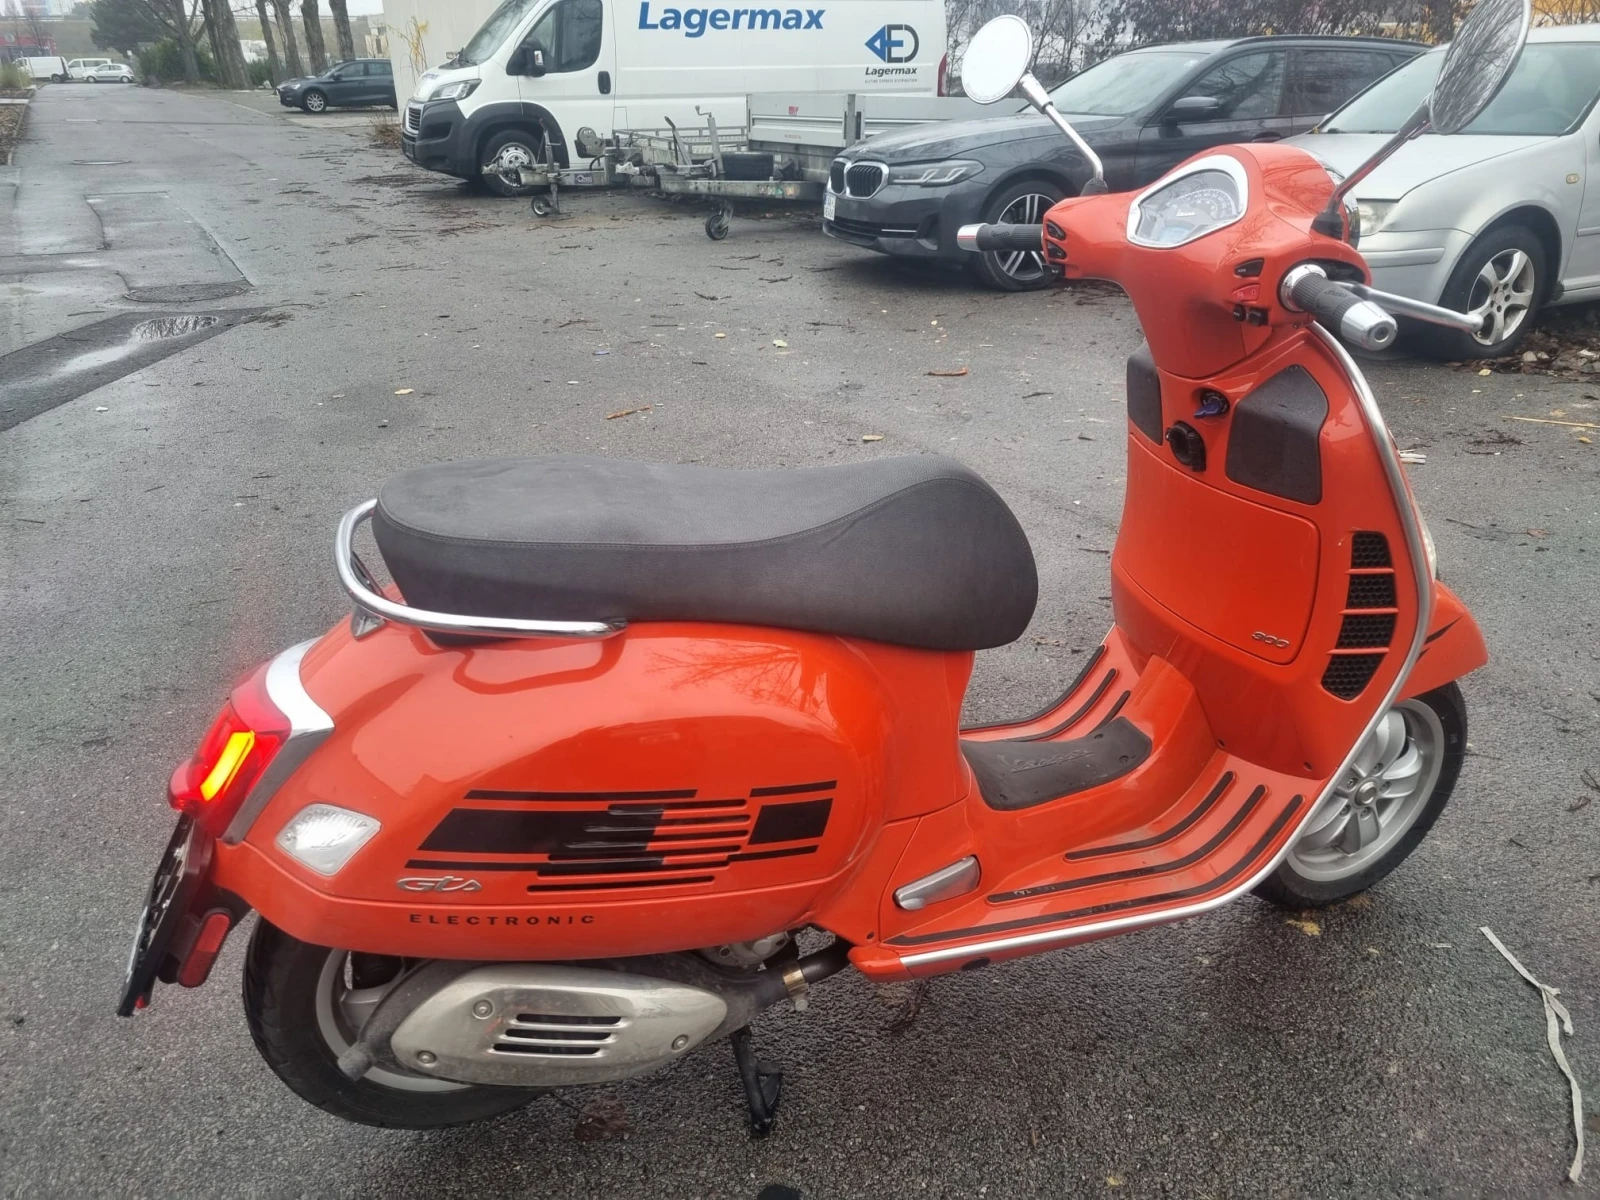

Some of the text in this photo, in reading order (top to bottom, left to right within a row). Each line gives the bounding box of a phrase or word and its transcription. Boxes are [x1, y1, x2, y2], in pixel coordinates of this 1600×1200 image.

[638, 2, 826, 38] Lagermax
[865, 66, 918, 78] Lagermax
[409, 913, 595, 926] ELECTRONIC
